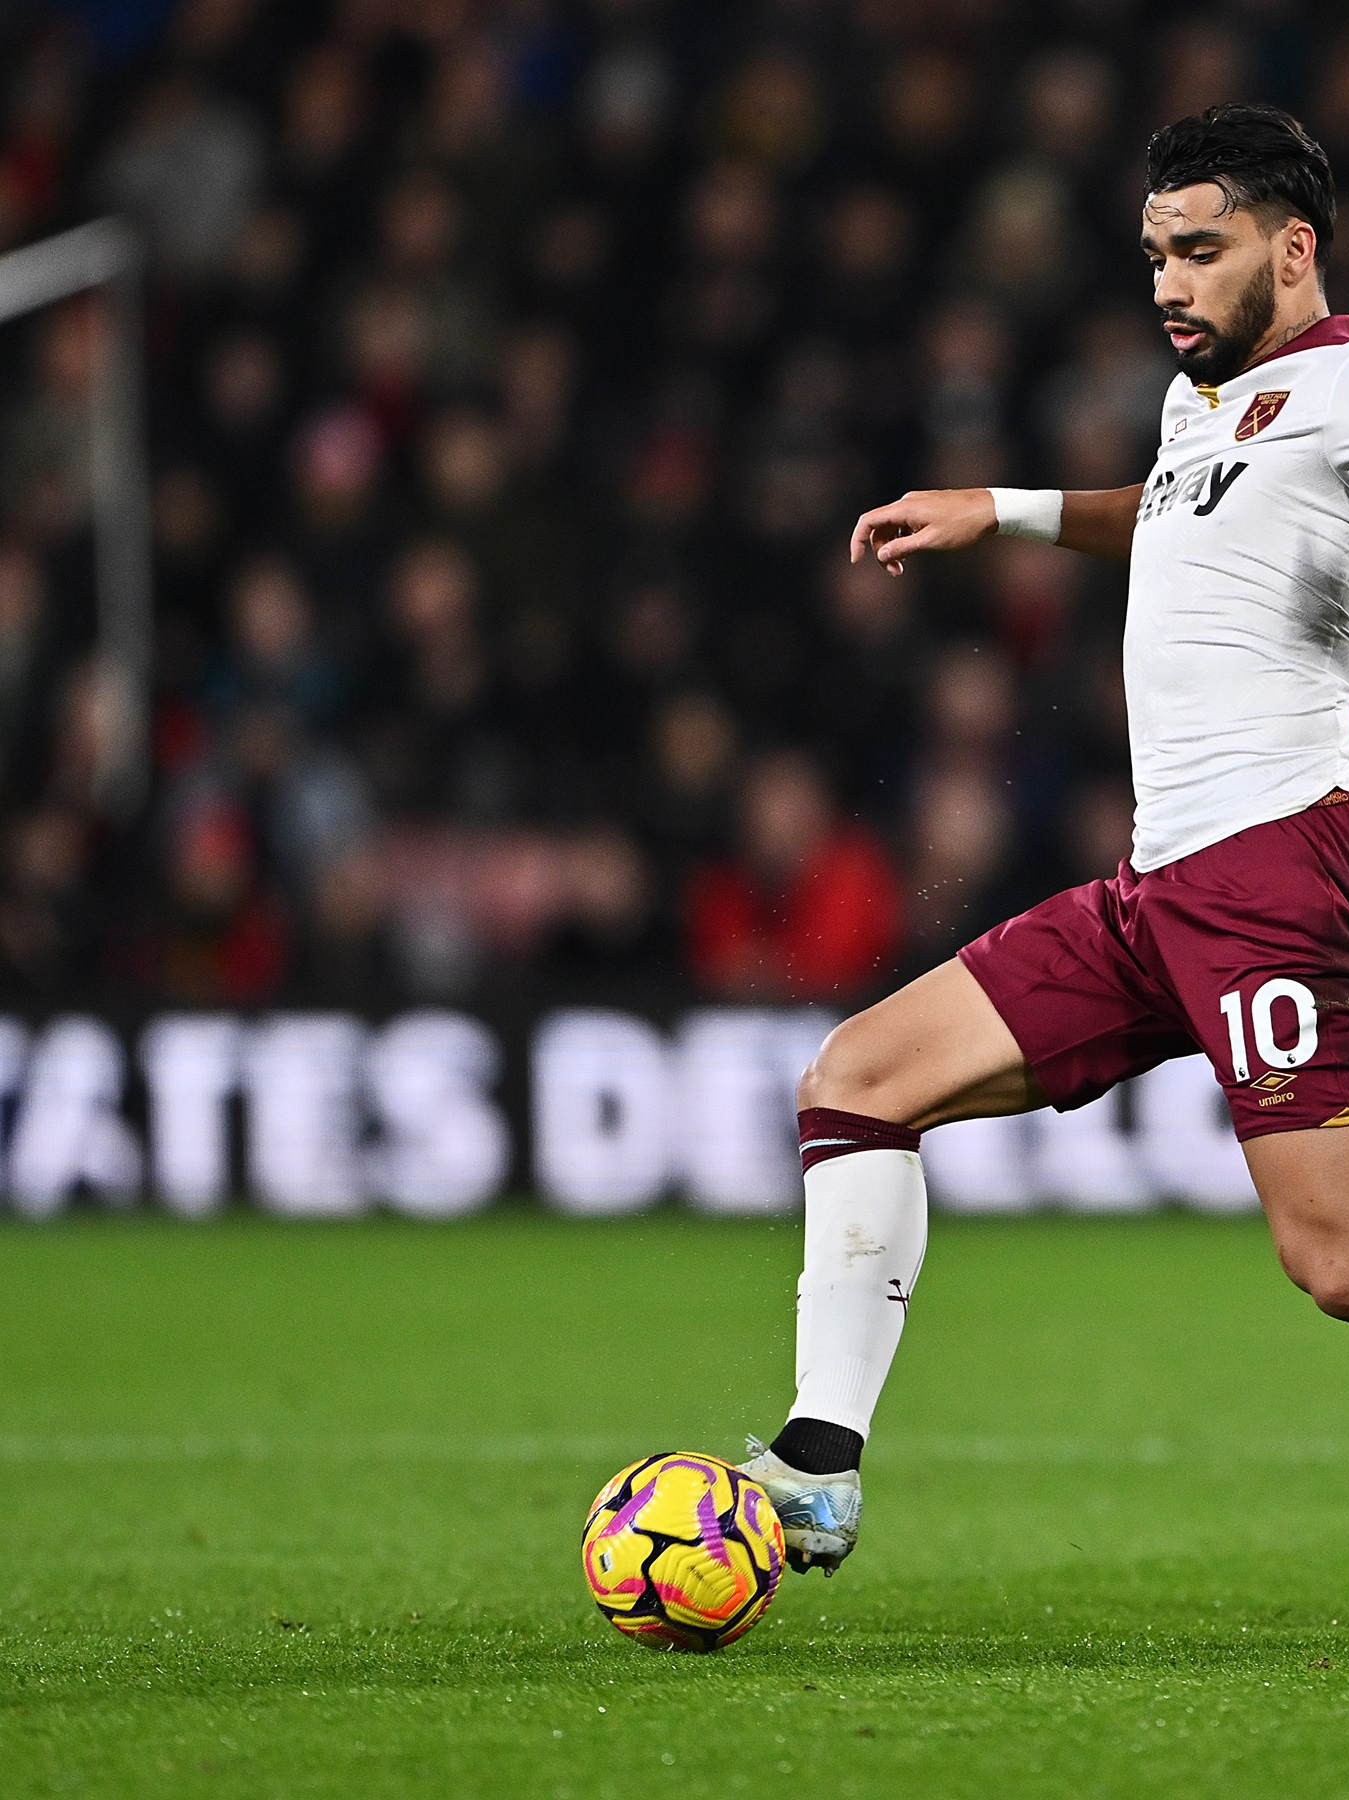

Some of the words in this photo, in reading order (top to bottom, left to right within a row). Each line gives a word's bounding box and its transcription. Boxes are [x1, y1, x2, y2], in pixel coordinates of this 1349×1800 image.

[1322, 790, 1349, 807] UMBRO
[1219, 977, 1319, 1083] 10
[0, 1010, 514, 1222] ATES
[1257, 1091, 1295, 1107] umbro
